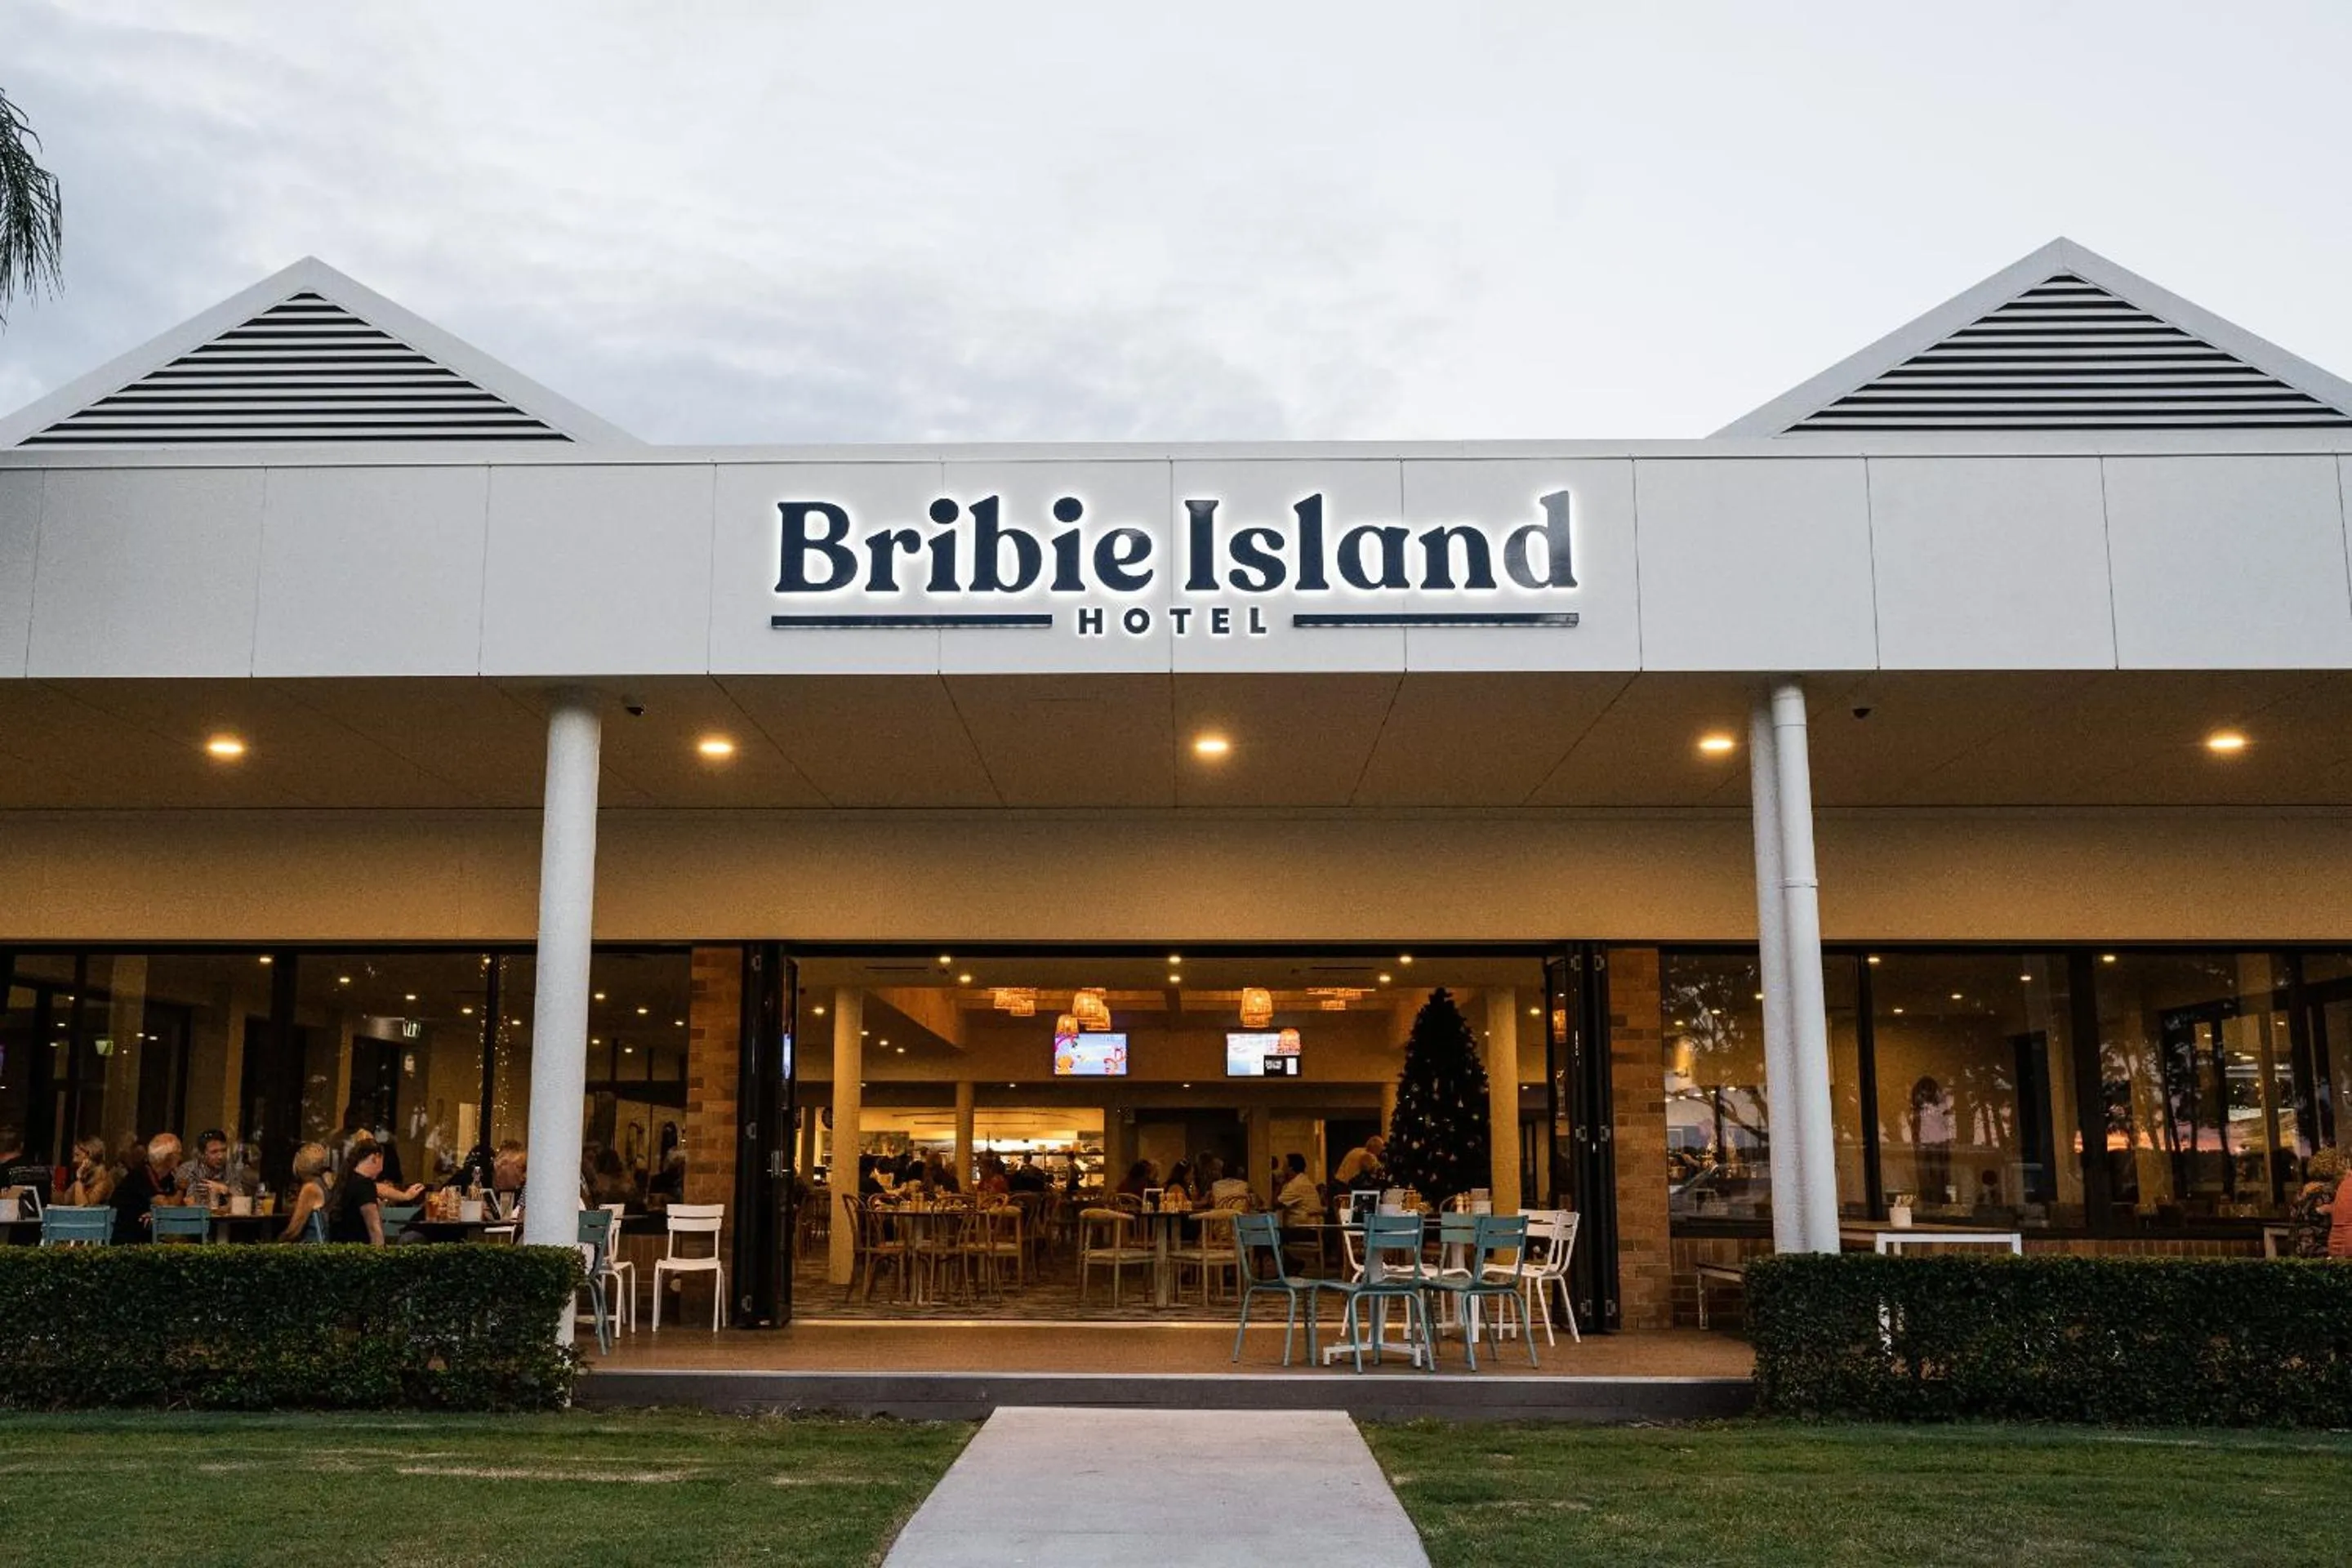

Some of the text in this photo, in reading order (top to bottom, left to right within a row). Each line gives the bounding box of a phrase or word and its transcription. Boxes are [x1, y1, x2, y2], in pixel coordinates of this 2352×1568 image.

[774, 490, 1578, 593] Bribie Island
[1078, 608, 1267, 635] HOTEL
